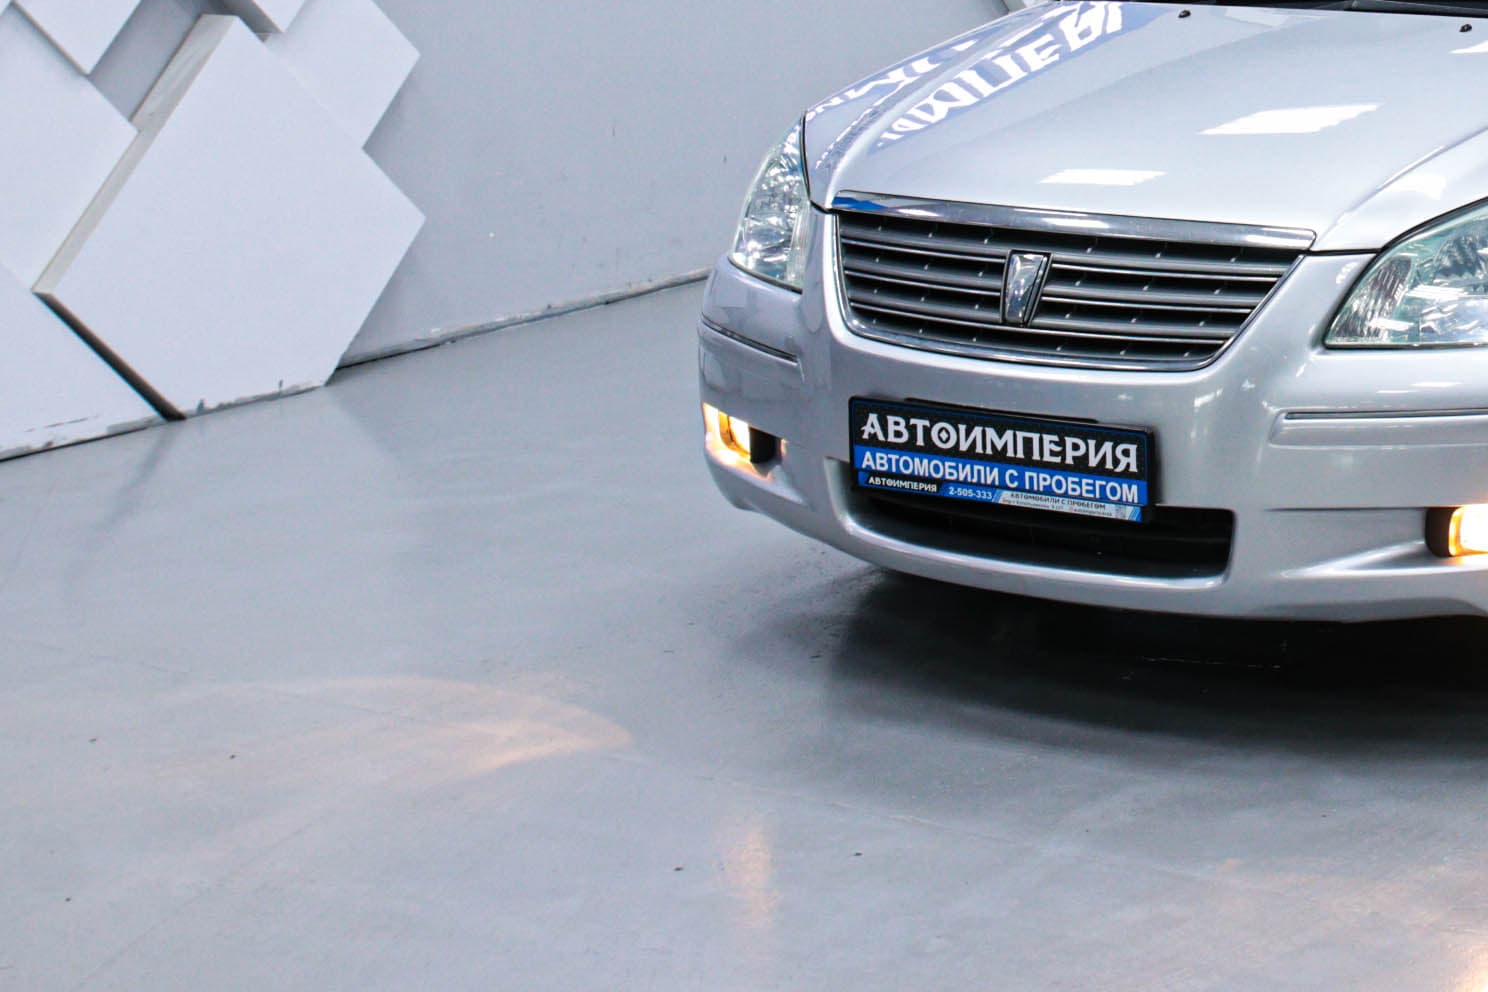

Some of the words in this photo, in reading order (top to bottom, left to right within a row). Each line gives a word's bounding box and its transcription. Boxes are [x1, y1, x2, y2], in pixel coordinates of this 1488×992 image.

[861, 413, 1138, 472] АВТОИМПЕРИЯ
[862, 451, 999, 486] АВТОМОБИЛИ
[1005, 469, 1018, 488] С
[1025, 472, 1138, 503] ПРОБЕГОМ
[868, 476, 937, 492] АВТОИМПЕРИЯ
[949, 487, 992, 499] 2-505-333
[1010, 493, 1060, 504] АВТОМОБИЛИ
[1067, 499, 1106, 509] ПРОБЕГОМ
